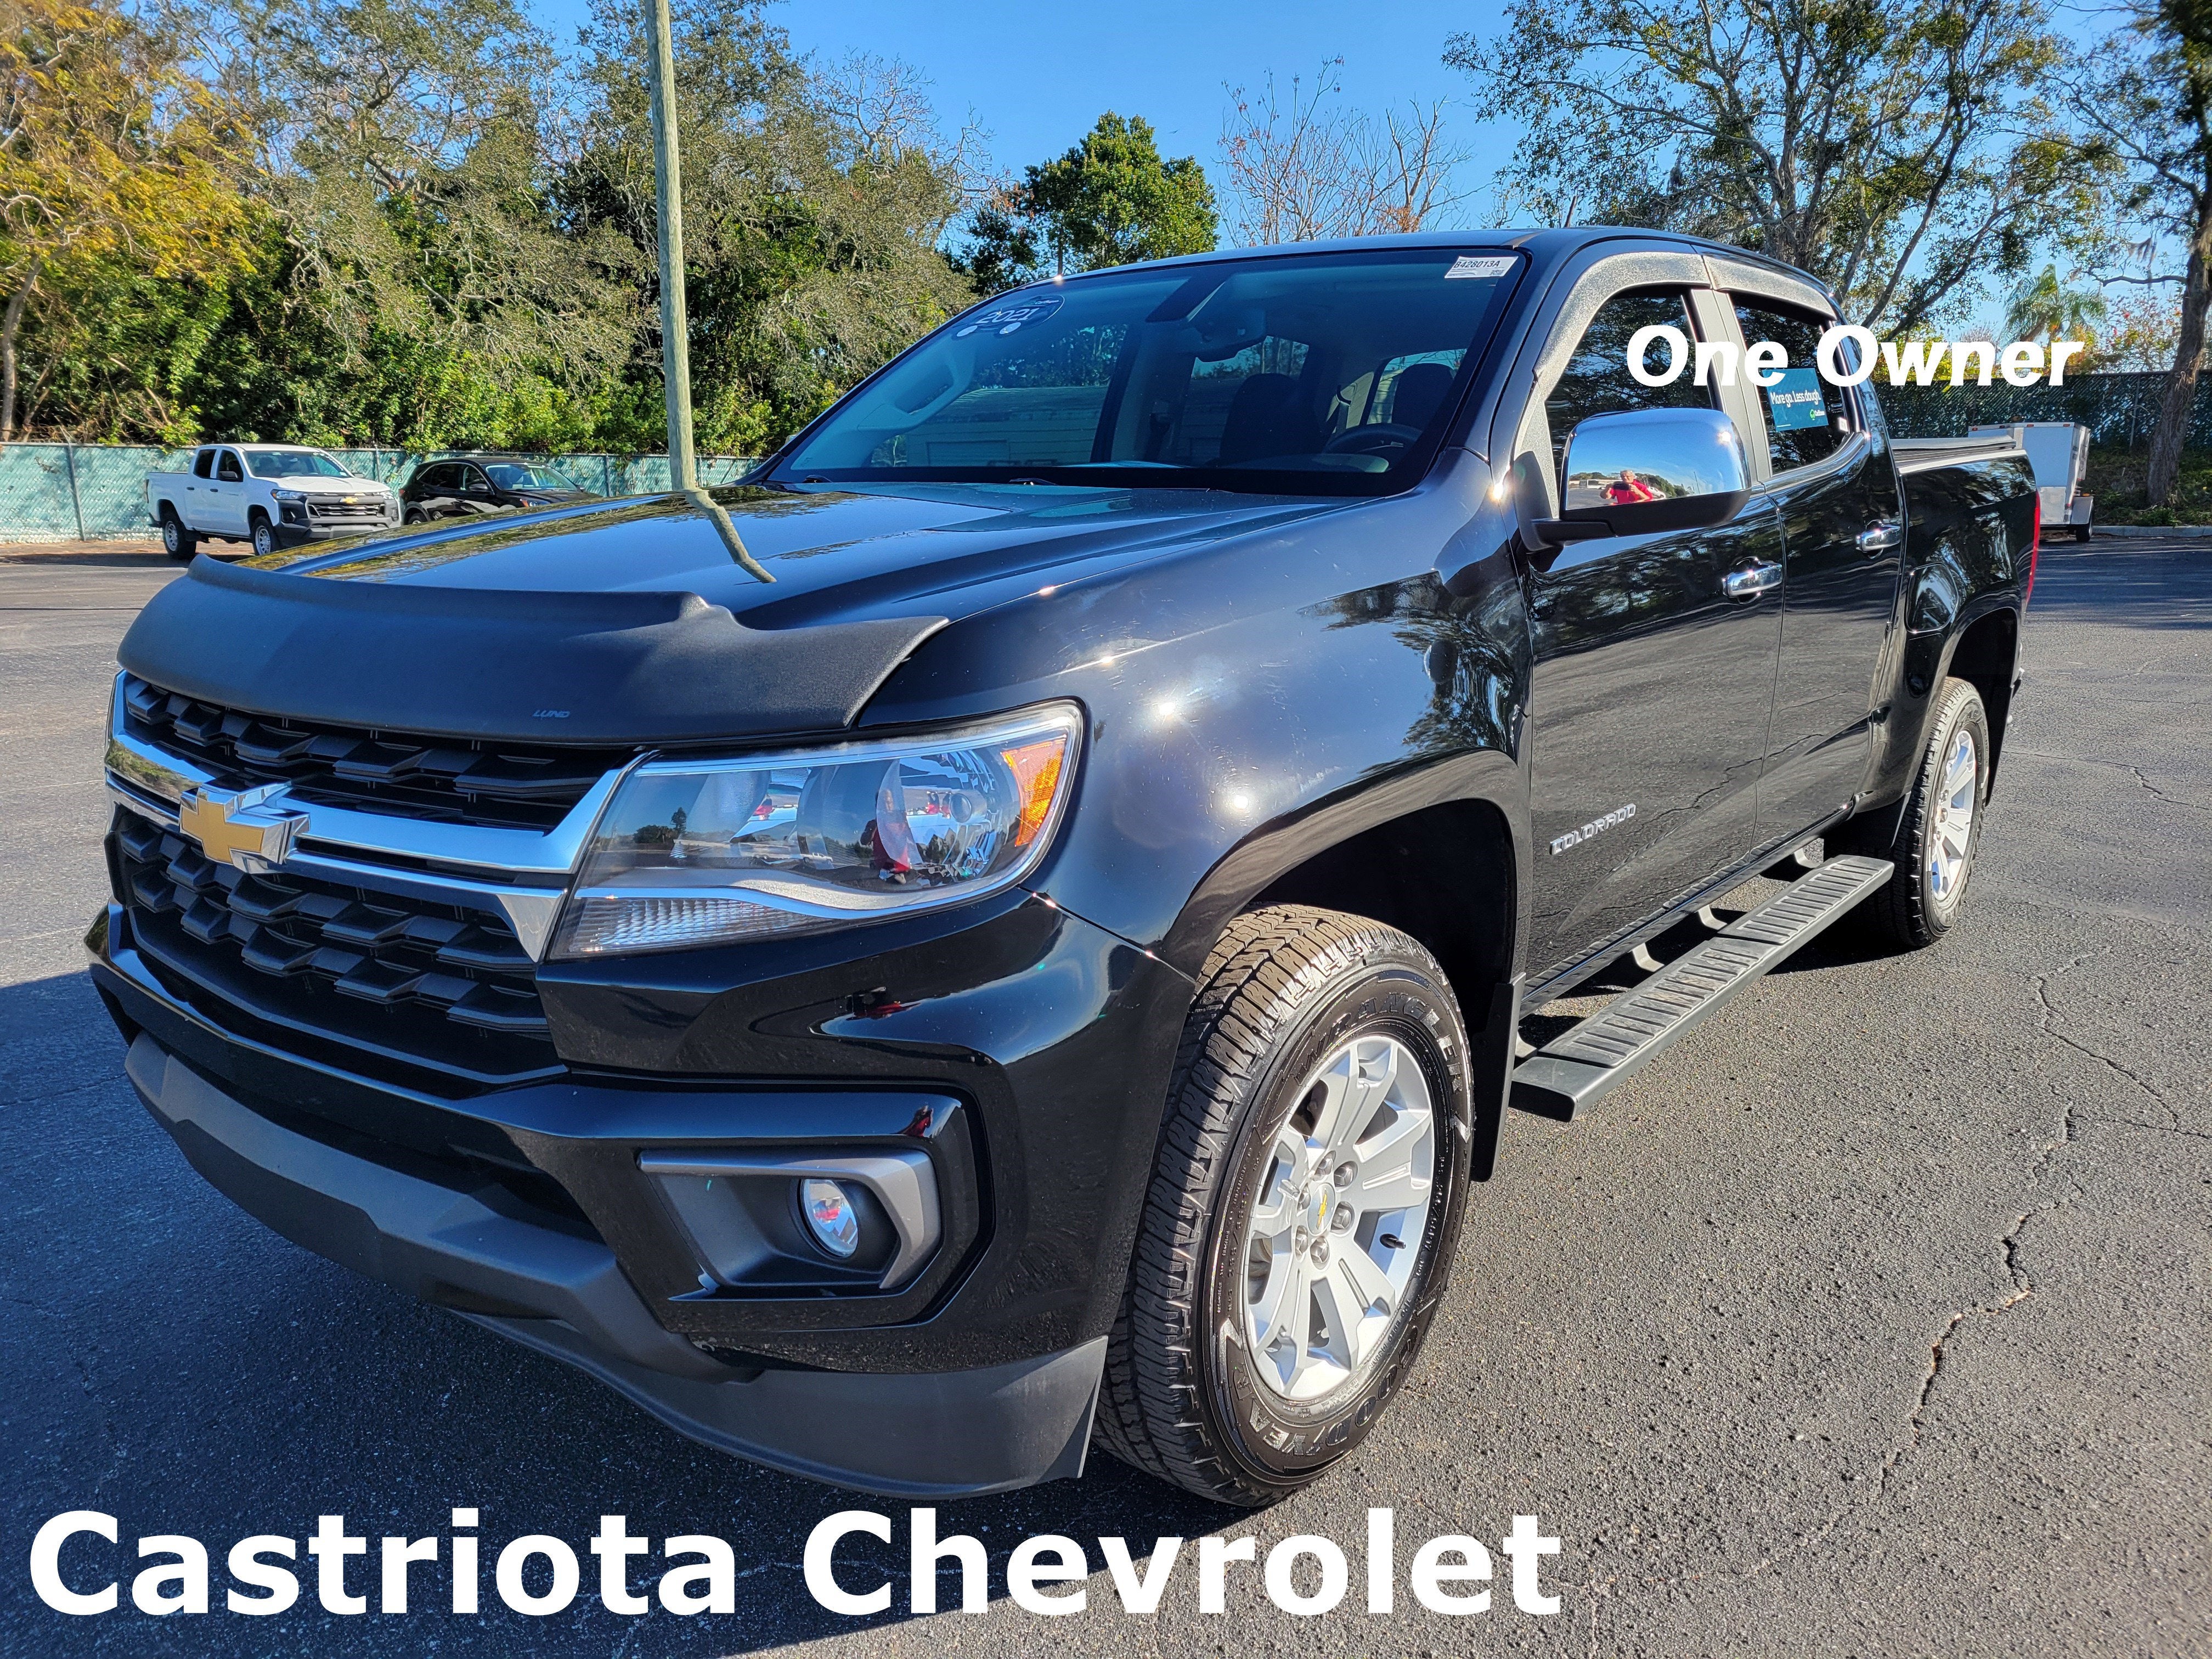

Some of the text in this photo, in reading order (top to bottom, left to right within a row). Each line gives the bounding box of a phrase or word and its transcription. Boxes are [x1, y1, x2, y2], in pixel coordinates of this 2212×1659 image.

[1453, 260, 1501, 268] B428013A
[975, 307, 1040, 324] 2021
[1770, 388, 1821, 408] More go. Less dough.
[532, 710, 571, 718] LUND
[1549, 803, 1637, 855] COLORADO
[1290, 991, 1463, 1094] WRANGLER
[1232, 1325, 1419, 1457] GOODYEAR
